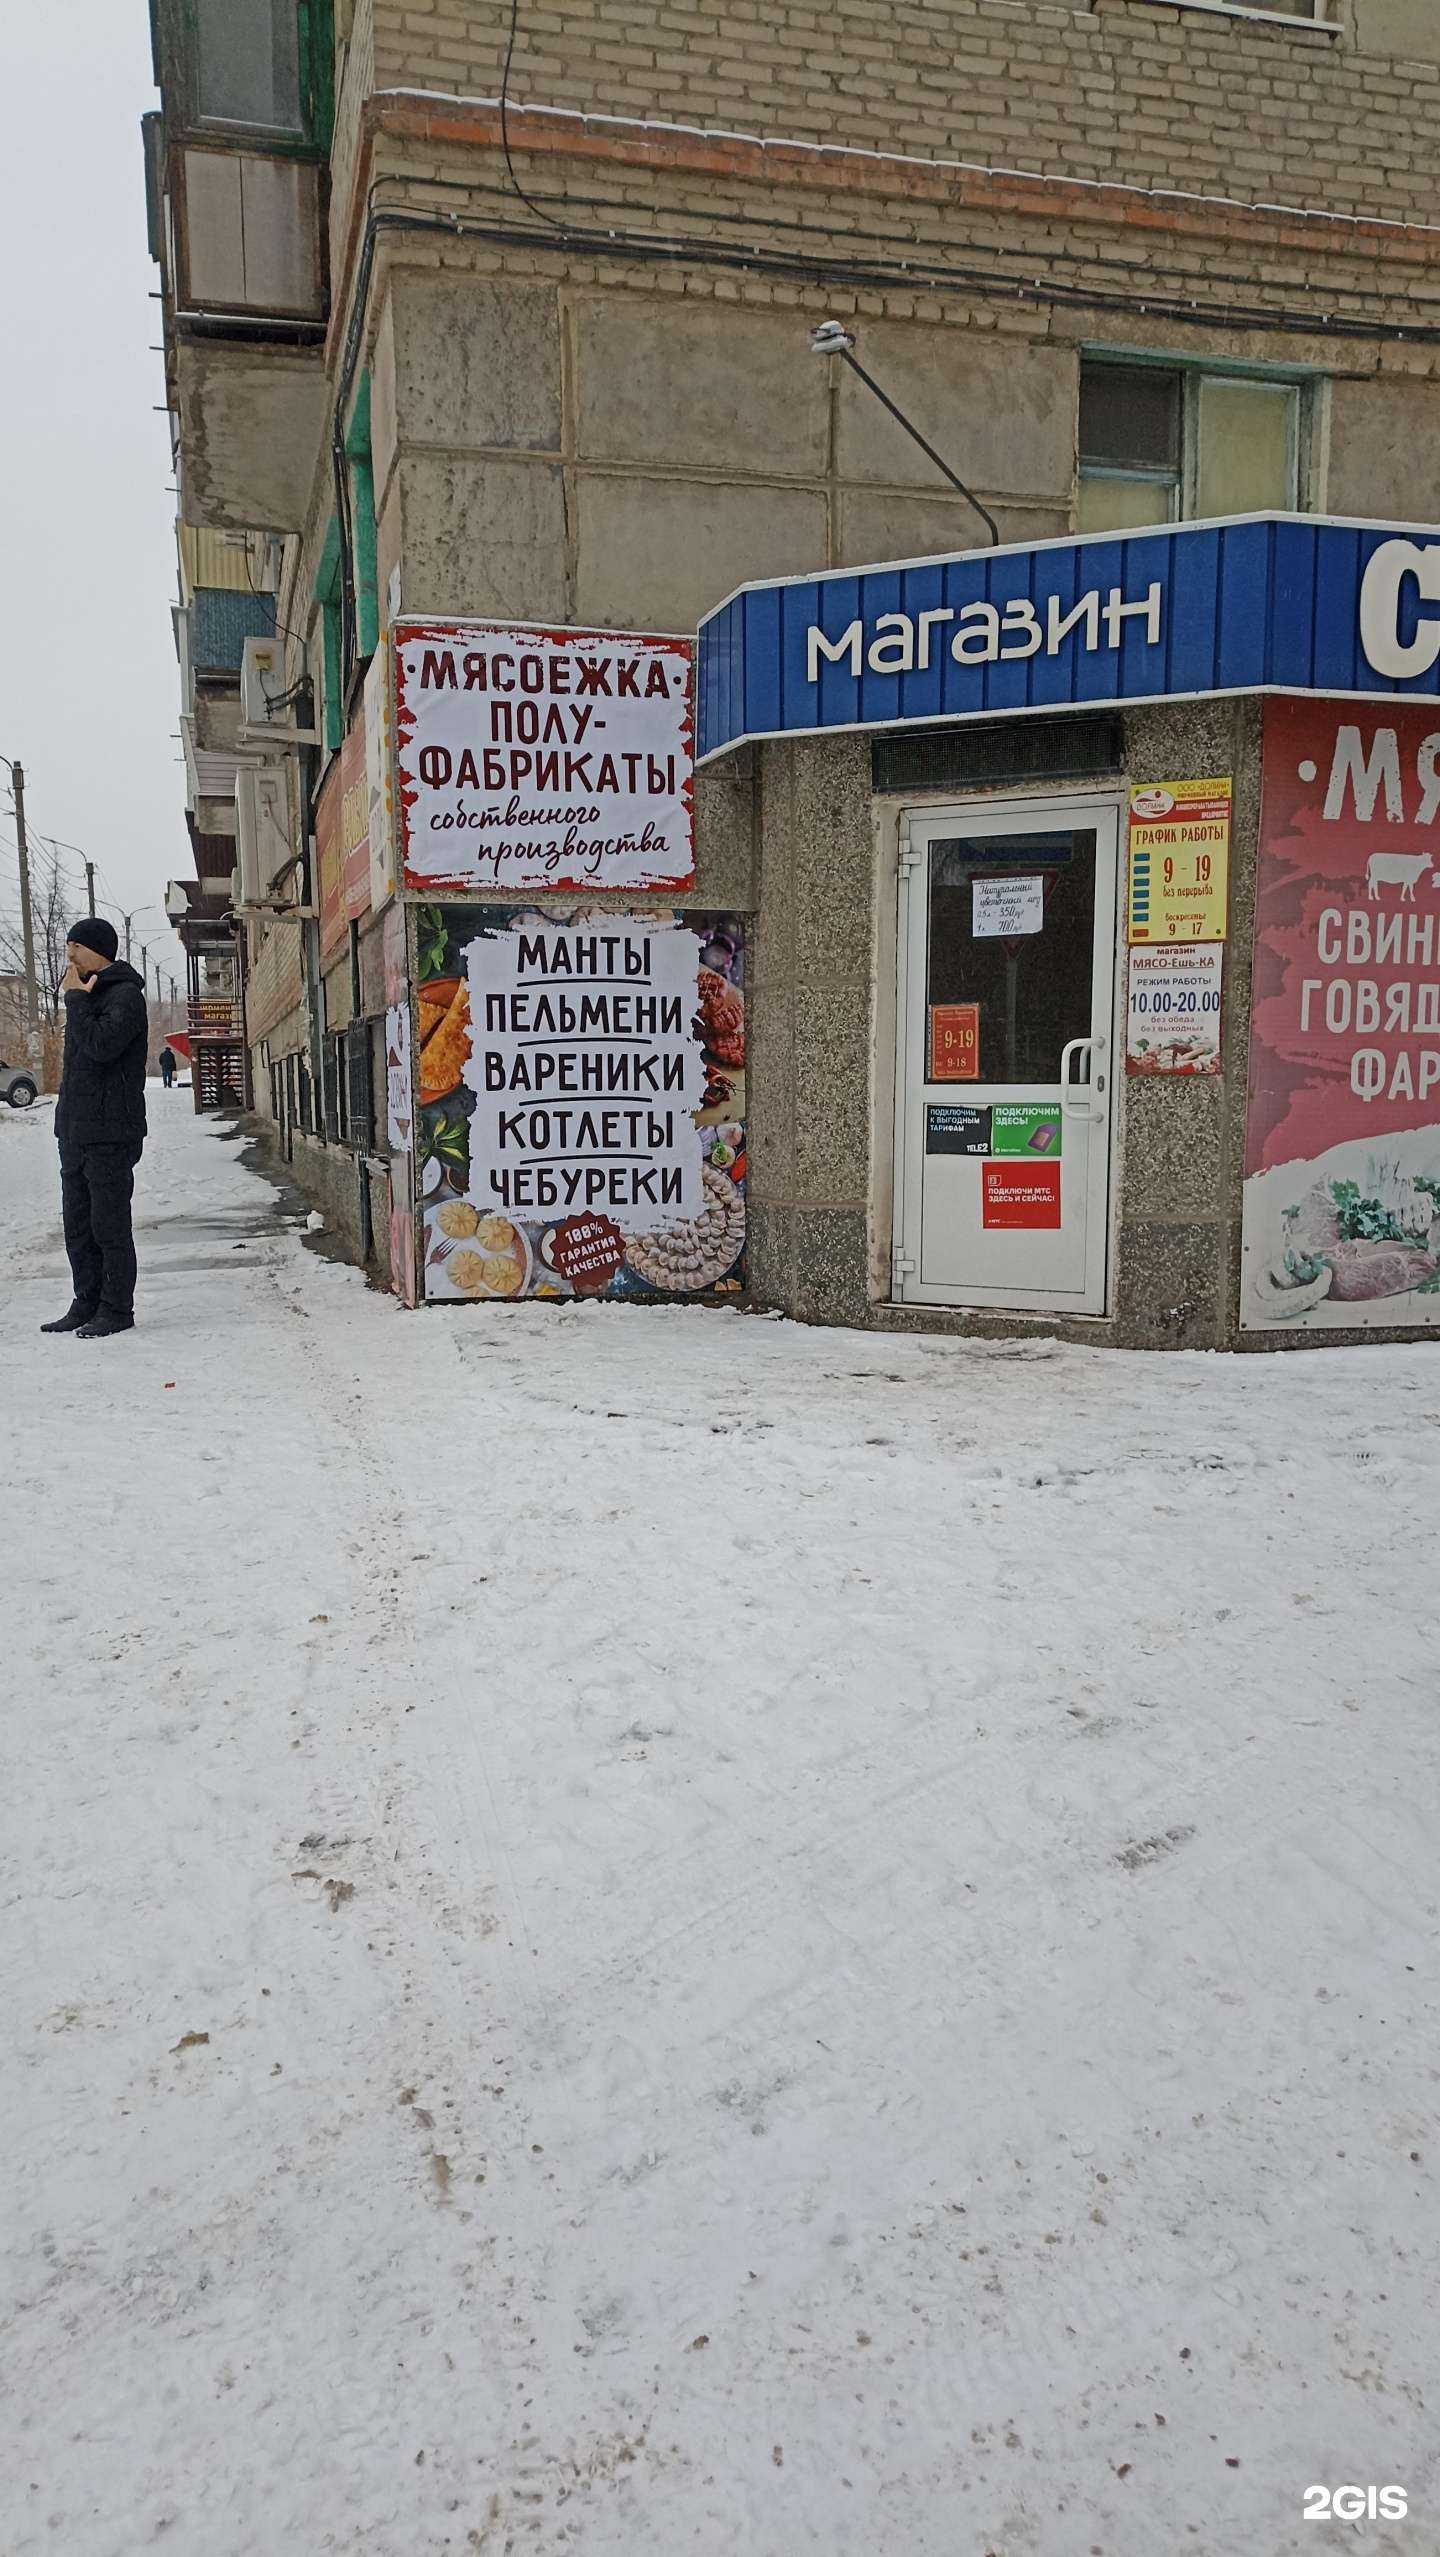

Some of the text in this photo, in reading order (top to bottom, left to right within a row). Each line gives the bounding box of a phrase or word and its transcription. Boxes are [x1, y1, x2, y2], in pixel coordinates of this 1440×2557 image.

[807, 581, 1161, 683] магазин
[420, 650, 671, 698] МЯСОЕЖКА
[491, 700, 606, 745] ПОЛУ-
[418, 745, 676, 795] ФАБРИКАТЫ
[430, 795, 601, 830] собственного
[478, 821, 670, 877] производства
[1136, 826, 1224, 845] ГРАФИК РАБОТЫ
[1163, 856, 1173, 883] 9
[1195, 854, 1211, 882] 19
[1317, 908, 1440, 965] СВИН
[517, 934, 650, 976] МАНТЫ
[1157, 947, 1196, 955] магазин
[1137, 977, 1211, 986] РЕЖИМ РАБОТЫ
[485, 994, 682, 1033] ПЕЛЬМЕНИ
[1130, 991, 1220, 1013] 10.00-20.00
[945, 1029, 974, 1049] 9-19
[485, 1052, 684, 1092] ВАРЕНИКИ
[947, 1057, 967, 1068] 9-18
[1350, 1048, 1440, 1102] ФАР
[930, 1108, 976, 1117] ПОДКЛЮЧИМ
[936, 1117, 980, 1125] ВЫГОДНЫМ
[995, 1107, 1059, 1117] ПОДКЛЮЧИМ
[995, 1116, 1028, 1126] ЗДЕСЬ!
[499, 1110, 673, 1149] КОТЛЕТЫ
[967, 1143, 988, 1153] TELE2
[490, 1168, 682, 1207] ЧЕБУРЕКИ
[988, 1187, 1032, 1196] ПОДКЛЮЧИ
[988, 1195, 1013, 1203] ЗДЕСЬ
[1022, 1194, 1055, 1202] СЕЙЧАС!
[565, 1221, 604, 1244] 100%
[560, 1236, 616, 1263] ГАРАНТИЯ
[565, 1250, 620, 1277] КАЧЕСТВА
